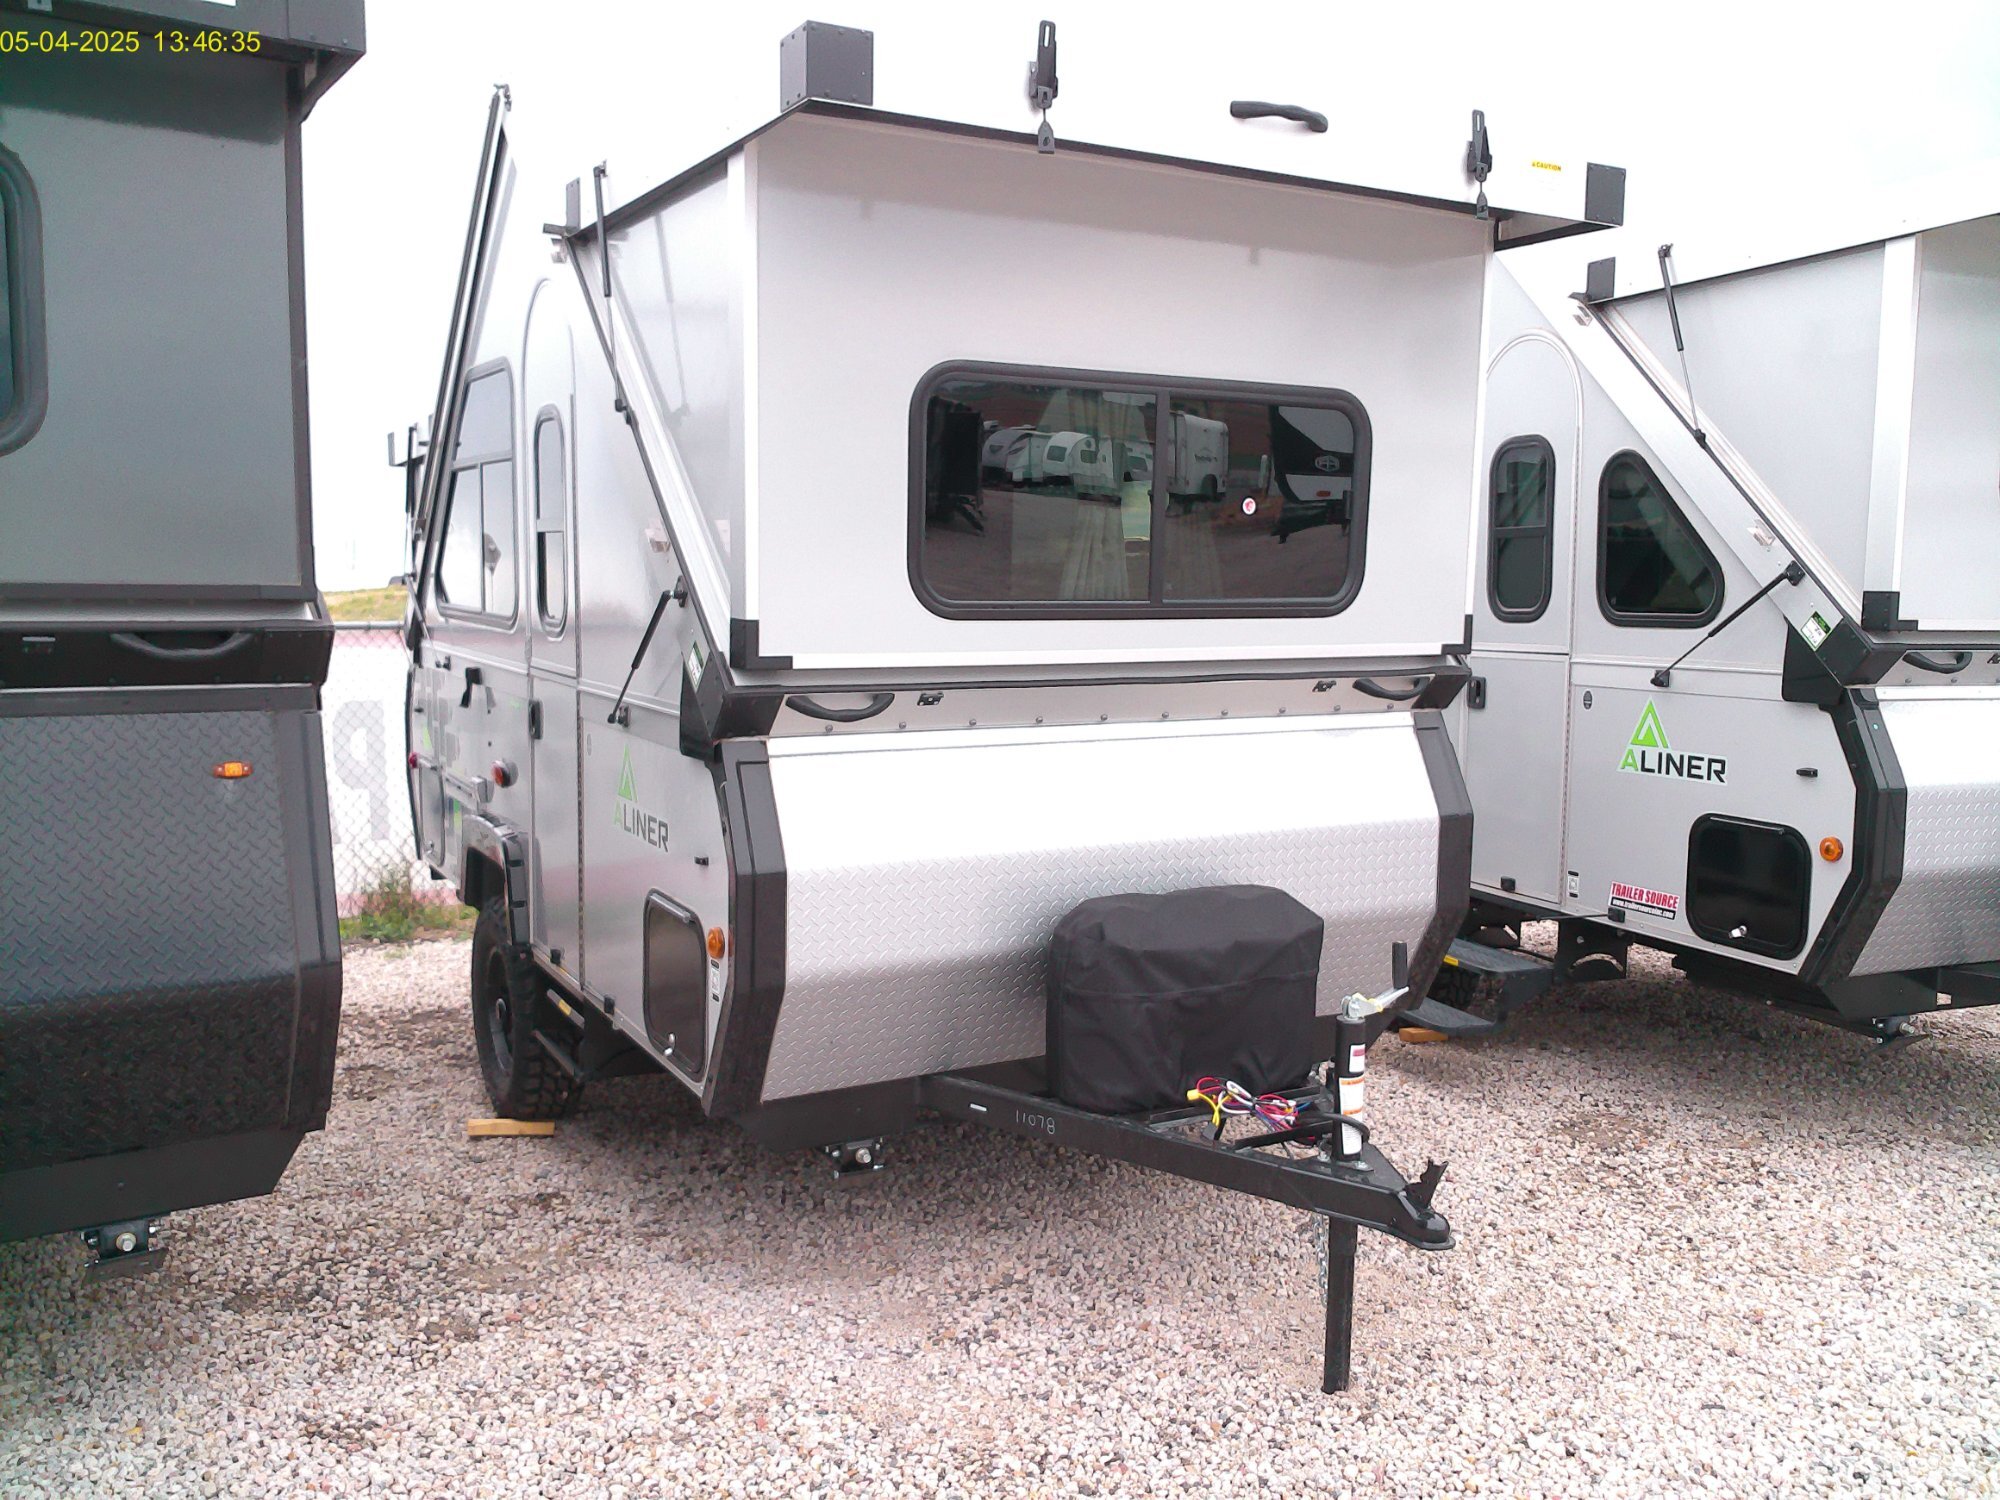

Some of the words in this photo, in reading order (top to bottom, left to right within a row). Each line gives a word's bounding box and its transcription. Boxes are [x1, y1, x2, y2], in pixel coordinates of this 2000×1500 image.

[1536, 161, 1562, 172] CAUTION
[1620, 748, 1726, 784] ALINER
[613, 799, 669, 853] ALINER
[1611, 883, 1644, 902] TRAILER
[1645, 889, 1679, 909] SOURCE
[1016, 1109, 1056, 1135] 11078
